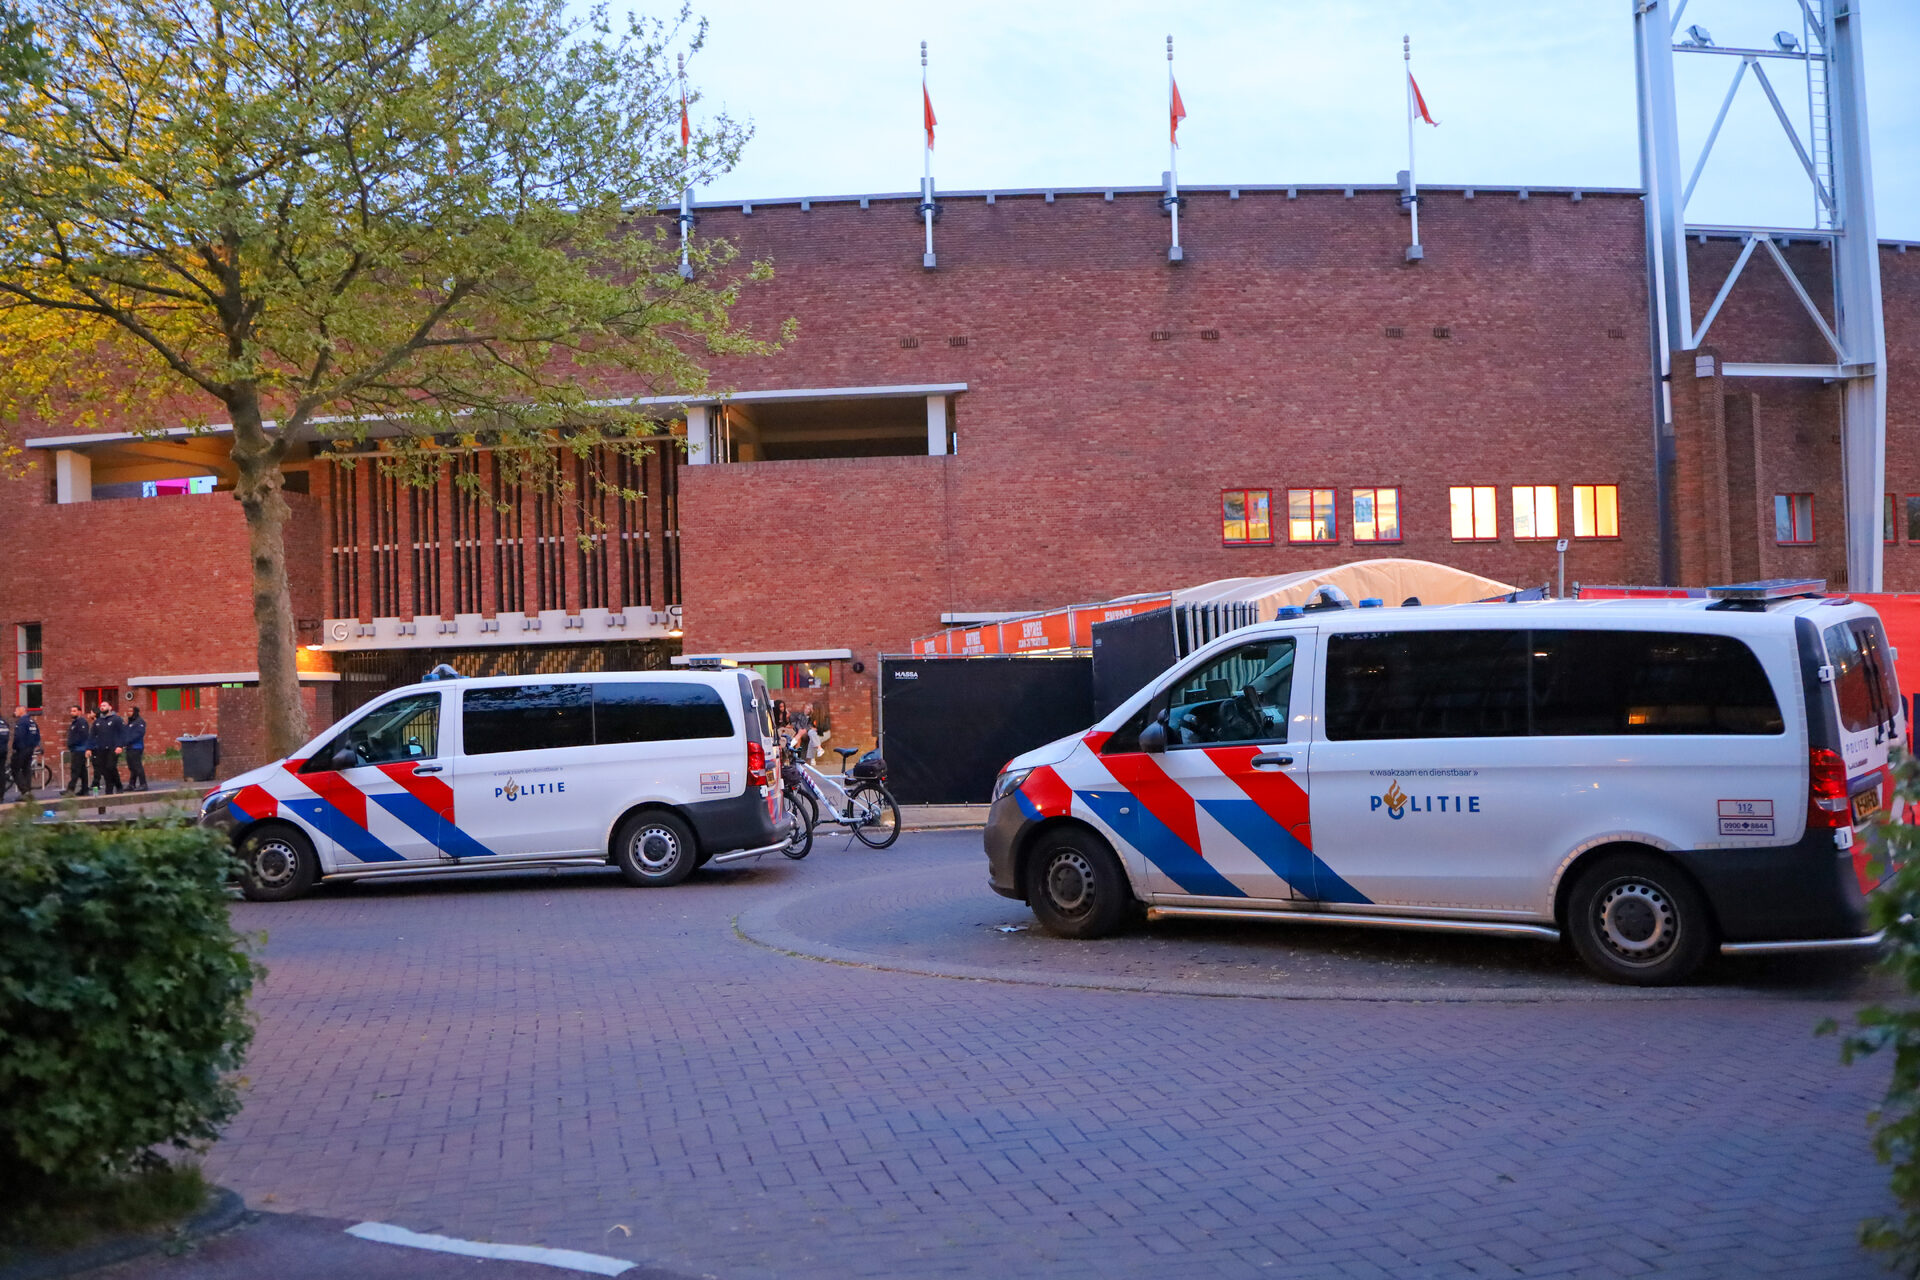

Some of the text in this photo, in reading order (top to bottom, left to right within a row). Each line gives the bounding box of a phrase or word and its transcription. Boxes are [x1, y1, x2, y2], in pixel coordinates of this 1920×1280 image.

[332, 622, 349, 641] G
[1429, 768, 1472, 776] dienstbaar
[495, 782, 565, 801] POLITIE
[1370, 795, 1480, 820] POLITIE
[1738, 803, 1753, 811] 112
